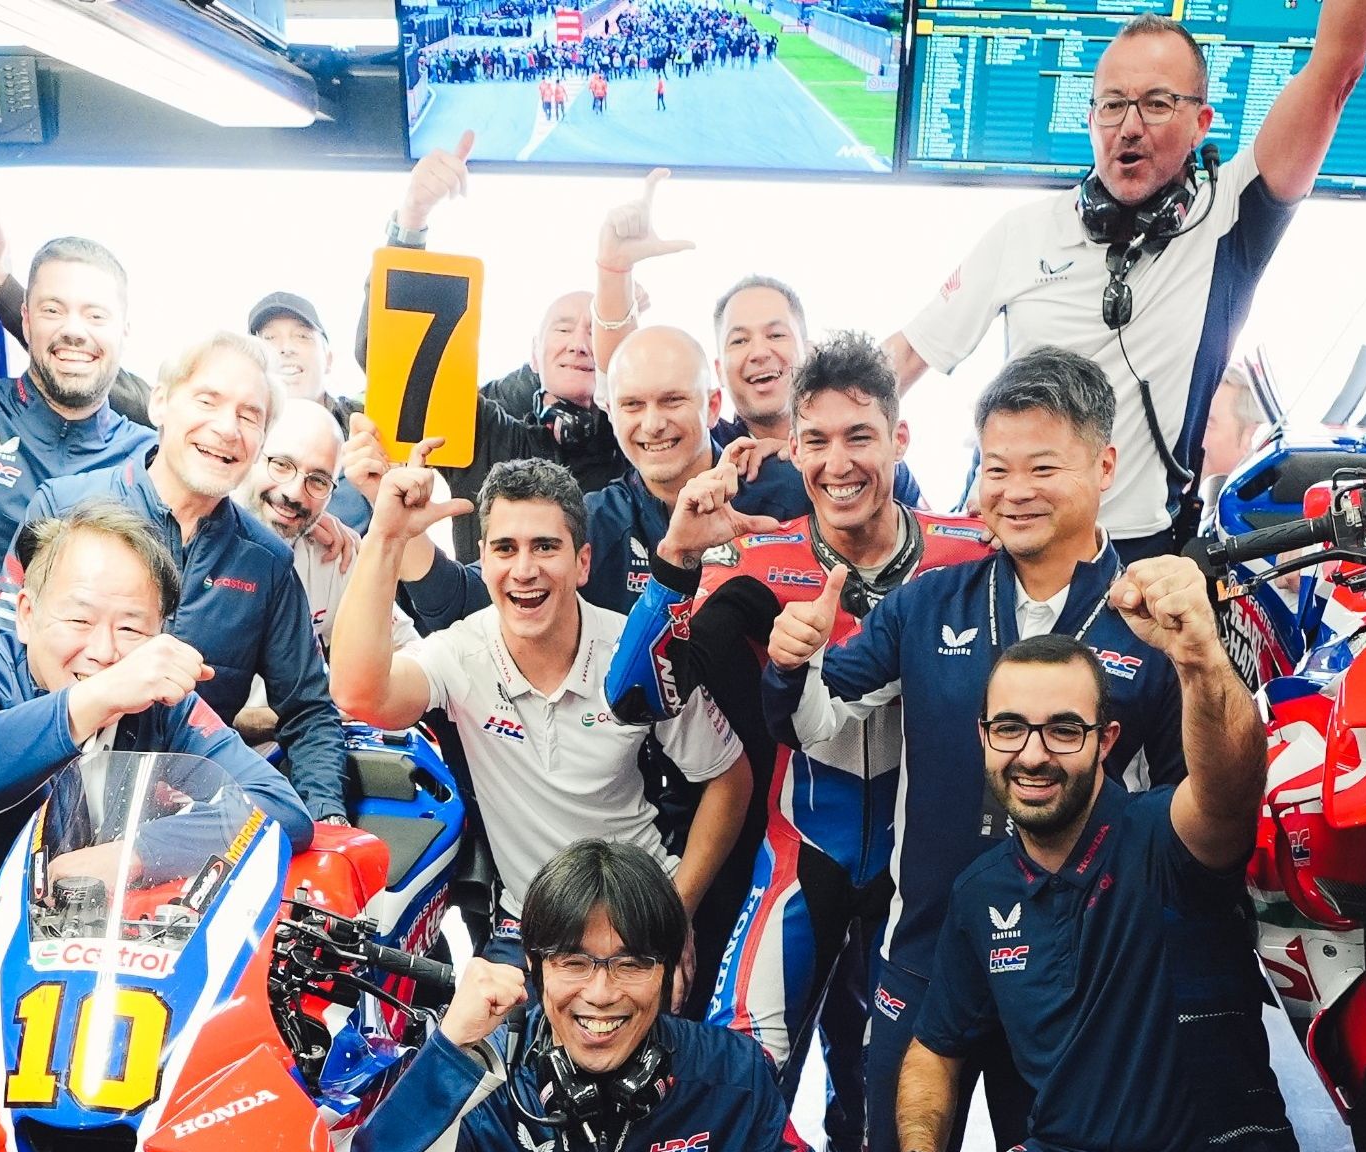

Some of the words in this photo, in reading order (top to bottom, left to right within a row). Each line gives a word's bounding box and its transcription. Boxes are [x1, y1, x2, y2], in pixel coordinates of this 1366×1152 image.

[386, 269, 470, 443] 7
[766, 565, 824, 587] HRC
[581, 638, 596, 684] HONDA
[1076, 824, 1111, 875] HONDA
[709, 884, 766, 1019] HONDA
[989, 945, 1030, 970] HRC
[991, 930, 1022, 941] CASTORE
[4, 980, 174, 1115] 10
[170, 1088, 280, 1140] HONDA
